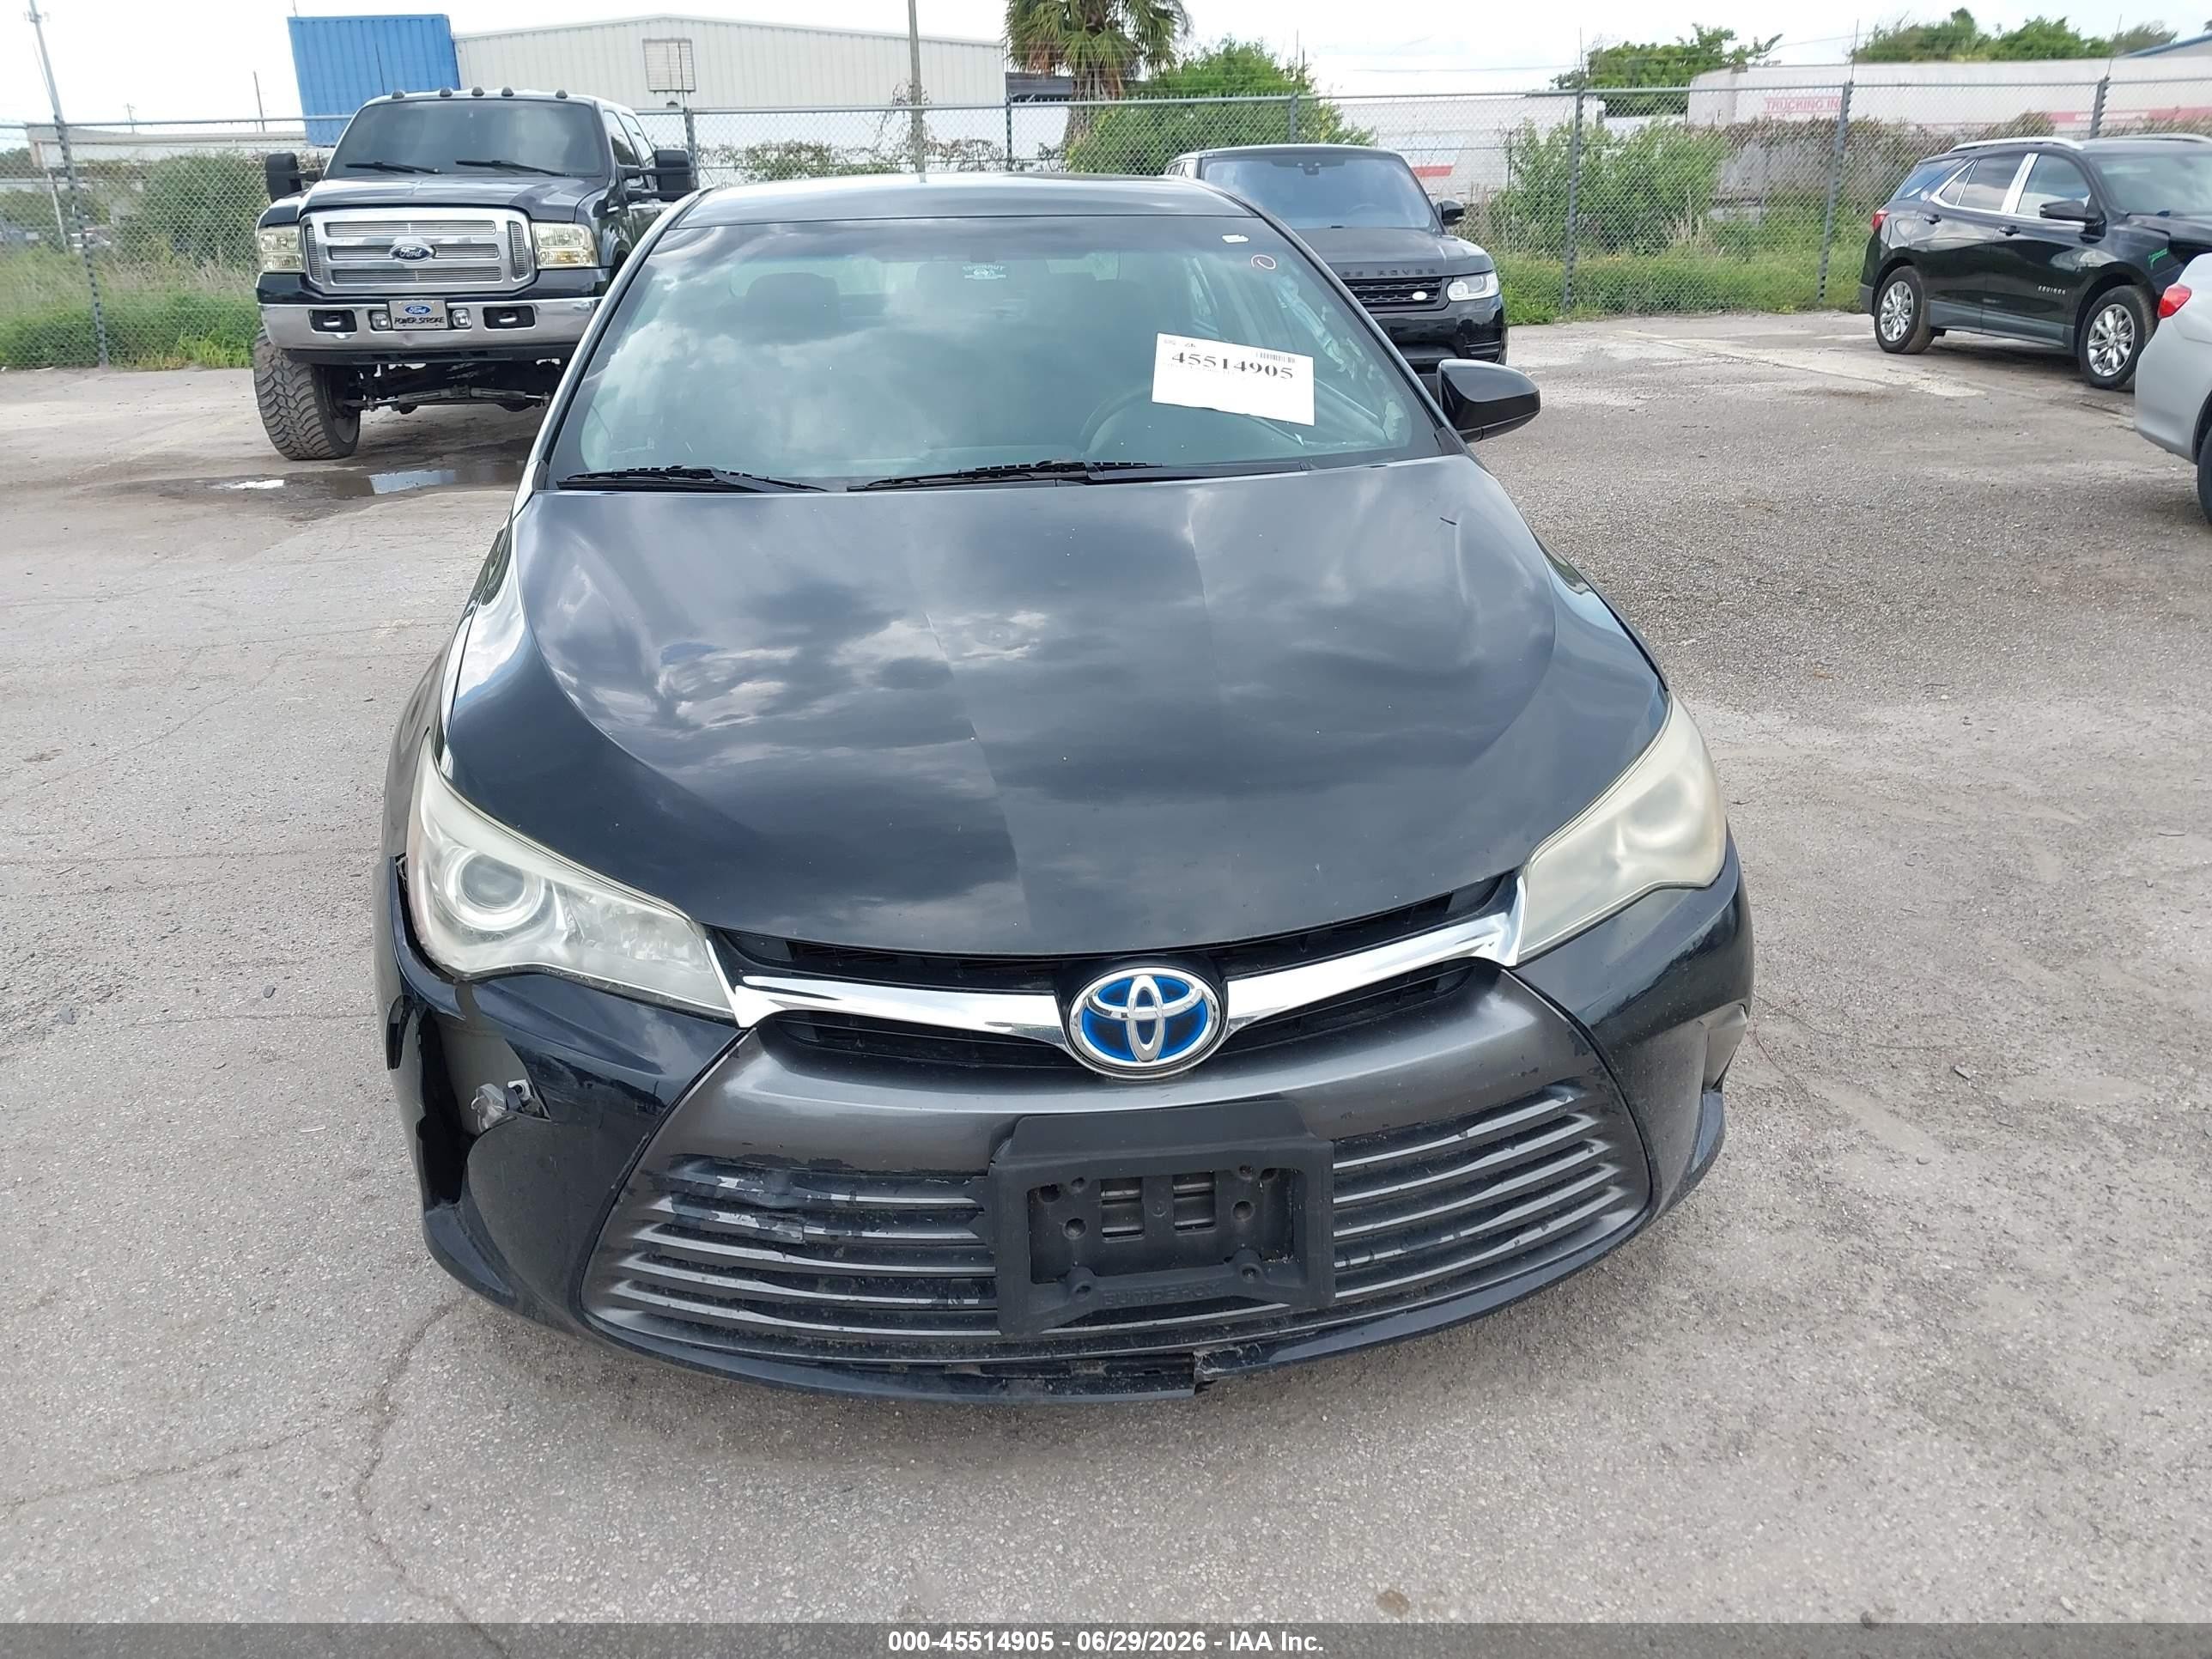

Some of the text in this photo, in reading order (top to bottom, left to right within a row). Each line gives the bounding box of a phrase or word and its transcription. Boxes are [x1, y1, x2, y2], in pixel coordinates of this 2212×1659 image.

[1765, 98, 1824, 112] TRUCKING
[398, 246, 422, 258] Ford
[394, 316, 445, 325] POWER STROKE
[1171, 352, 1294, 380] 45514905
